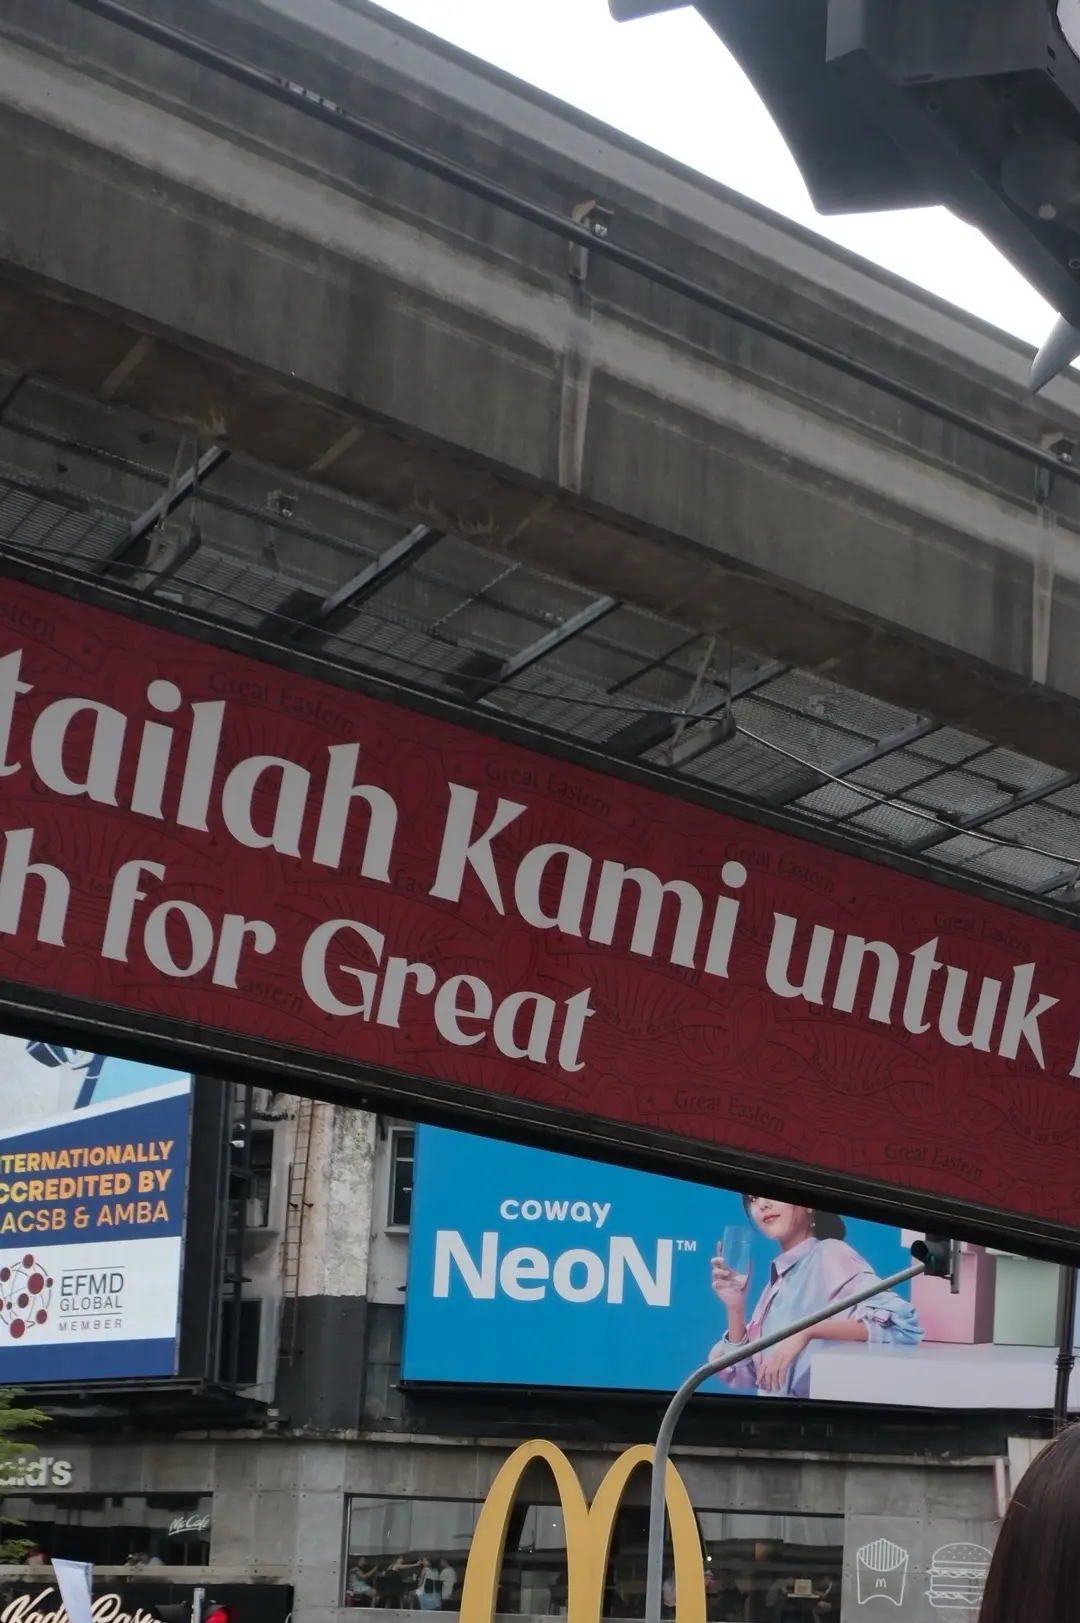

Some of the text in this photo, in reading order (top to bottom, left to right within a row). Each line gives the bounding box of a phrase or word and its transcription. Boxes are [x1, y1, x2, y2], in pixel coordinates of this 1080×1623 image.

[429, 781, 748, 980] Kami
[765, 911, 1060, 1070] untuk
[101, 860, 277, 990] for
[301, 918, 597, 1073] Great
[138, 1169, 173, 1194] BY
[74, 1207, 90, 1229] &
[96, 1201, 170, 1227] AMBA
[499, 1198, 612, 1229] coway
[60, 1271, 125, 1298] EFMD
[59, 1293, 123, 1314] GLOBAL
[58, 1318, 123, 1333] MEMBER
